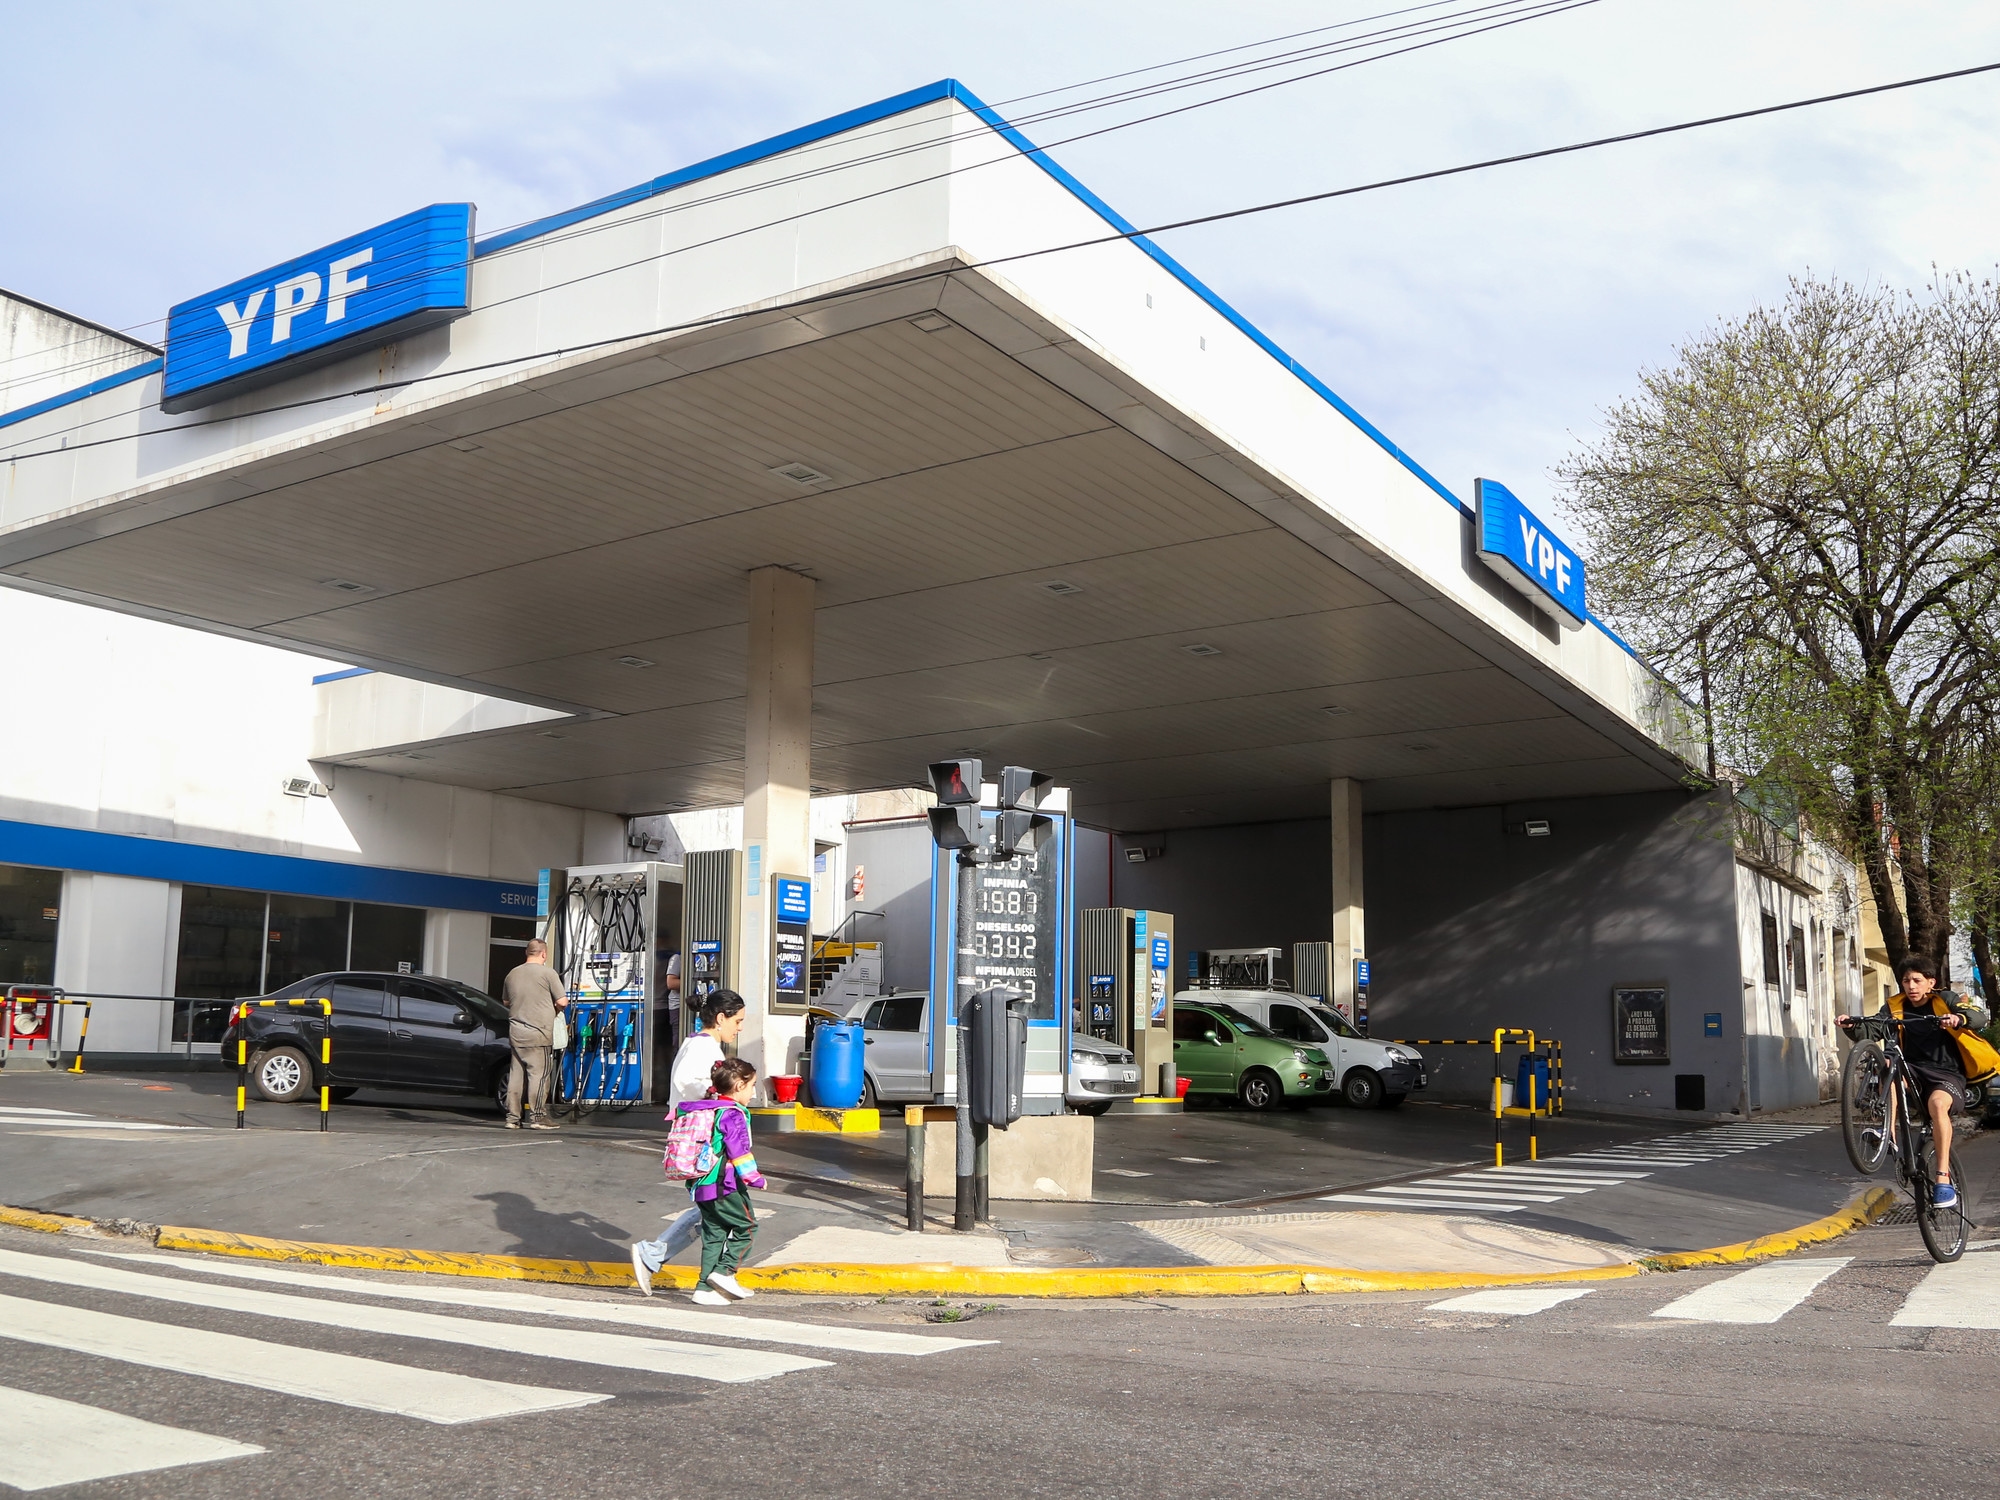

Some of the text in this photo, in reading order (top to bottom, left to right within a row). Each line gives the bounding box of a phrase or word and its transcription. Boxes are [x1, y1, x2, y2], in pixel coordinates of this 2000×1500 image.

[214, 246, 374, 361] YPF
[1518, 513, 1572, 595] YPF
[983, 878, 1028, 889] INFINIA
[500, 892, 537, 907] SERVIC
[776, 933, 805, 945] NFINIA
[975, 966, 1016, 977] NFINIA
